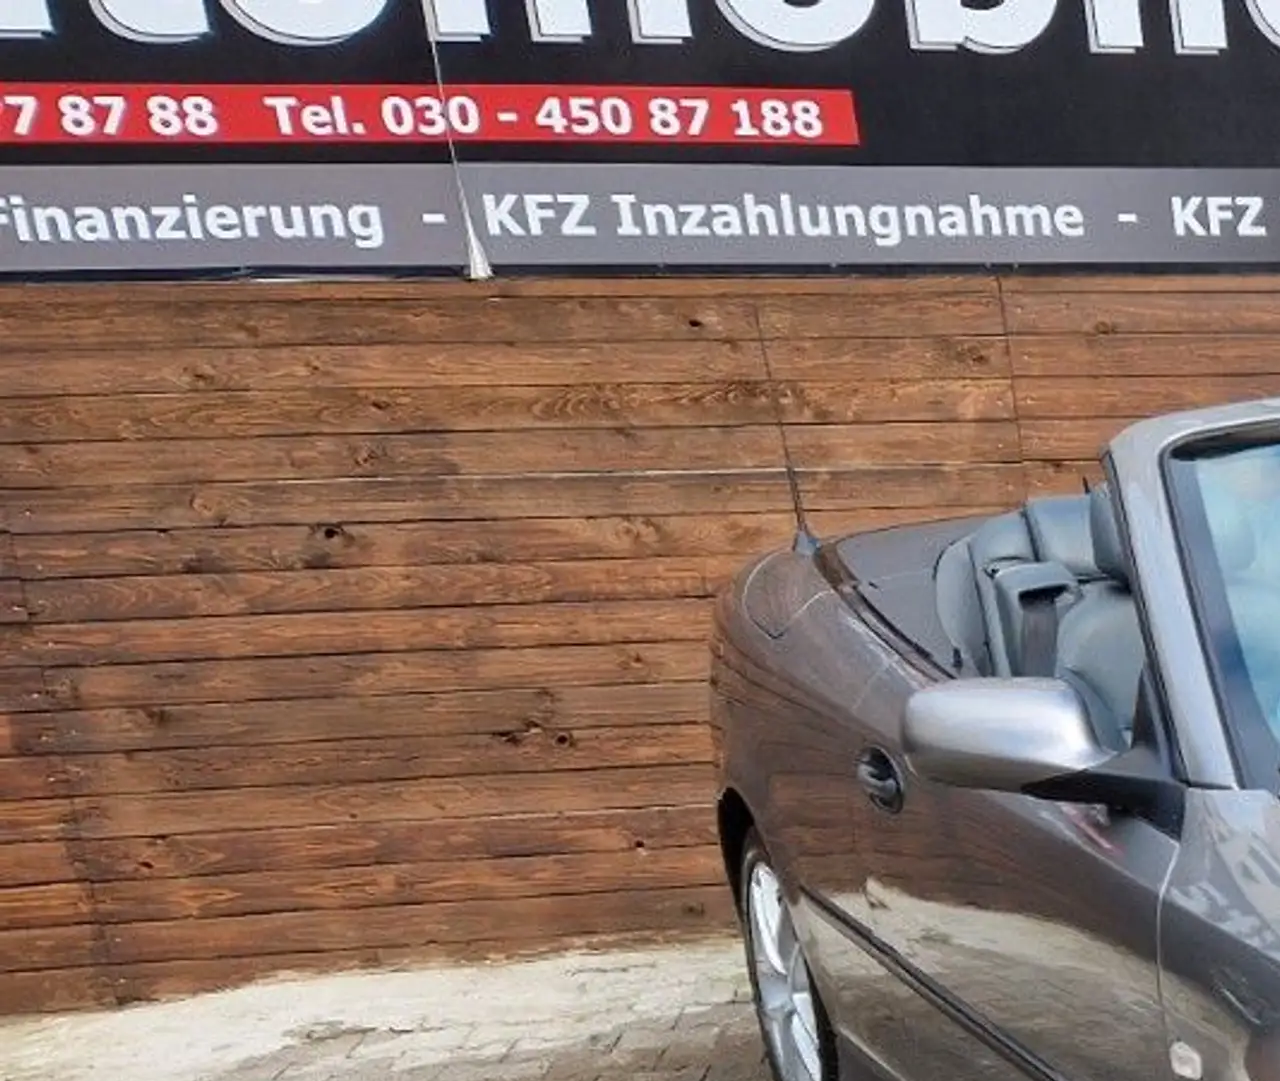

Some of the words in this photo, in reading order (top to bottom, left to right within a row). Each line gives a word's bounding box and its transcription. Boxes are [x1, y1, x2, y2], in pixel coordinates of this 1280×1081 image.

[59, 96, 125, 135] 87
[147, 96, 217, 135] 88
[264, 96, 364, 135] Tel.
[382, 96, 479, 134] 030
[536, 98, 632, 134] 450
[649, 98, 708, 135] 87
[732, 100, 822, 137] 188
[483, 194, 596, 235] KFZ
[611, 193, 1084, 246] Inzahlungnahme
[1172, 197, 1266, 236] KFZ
